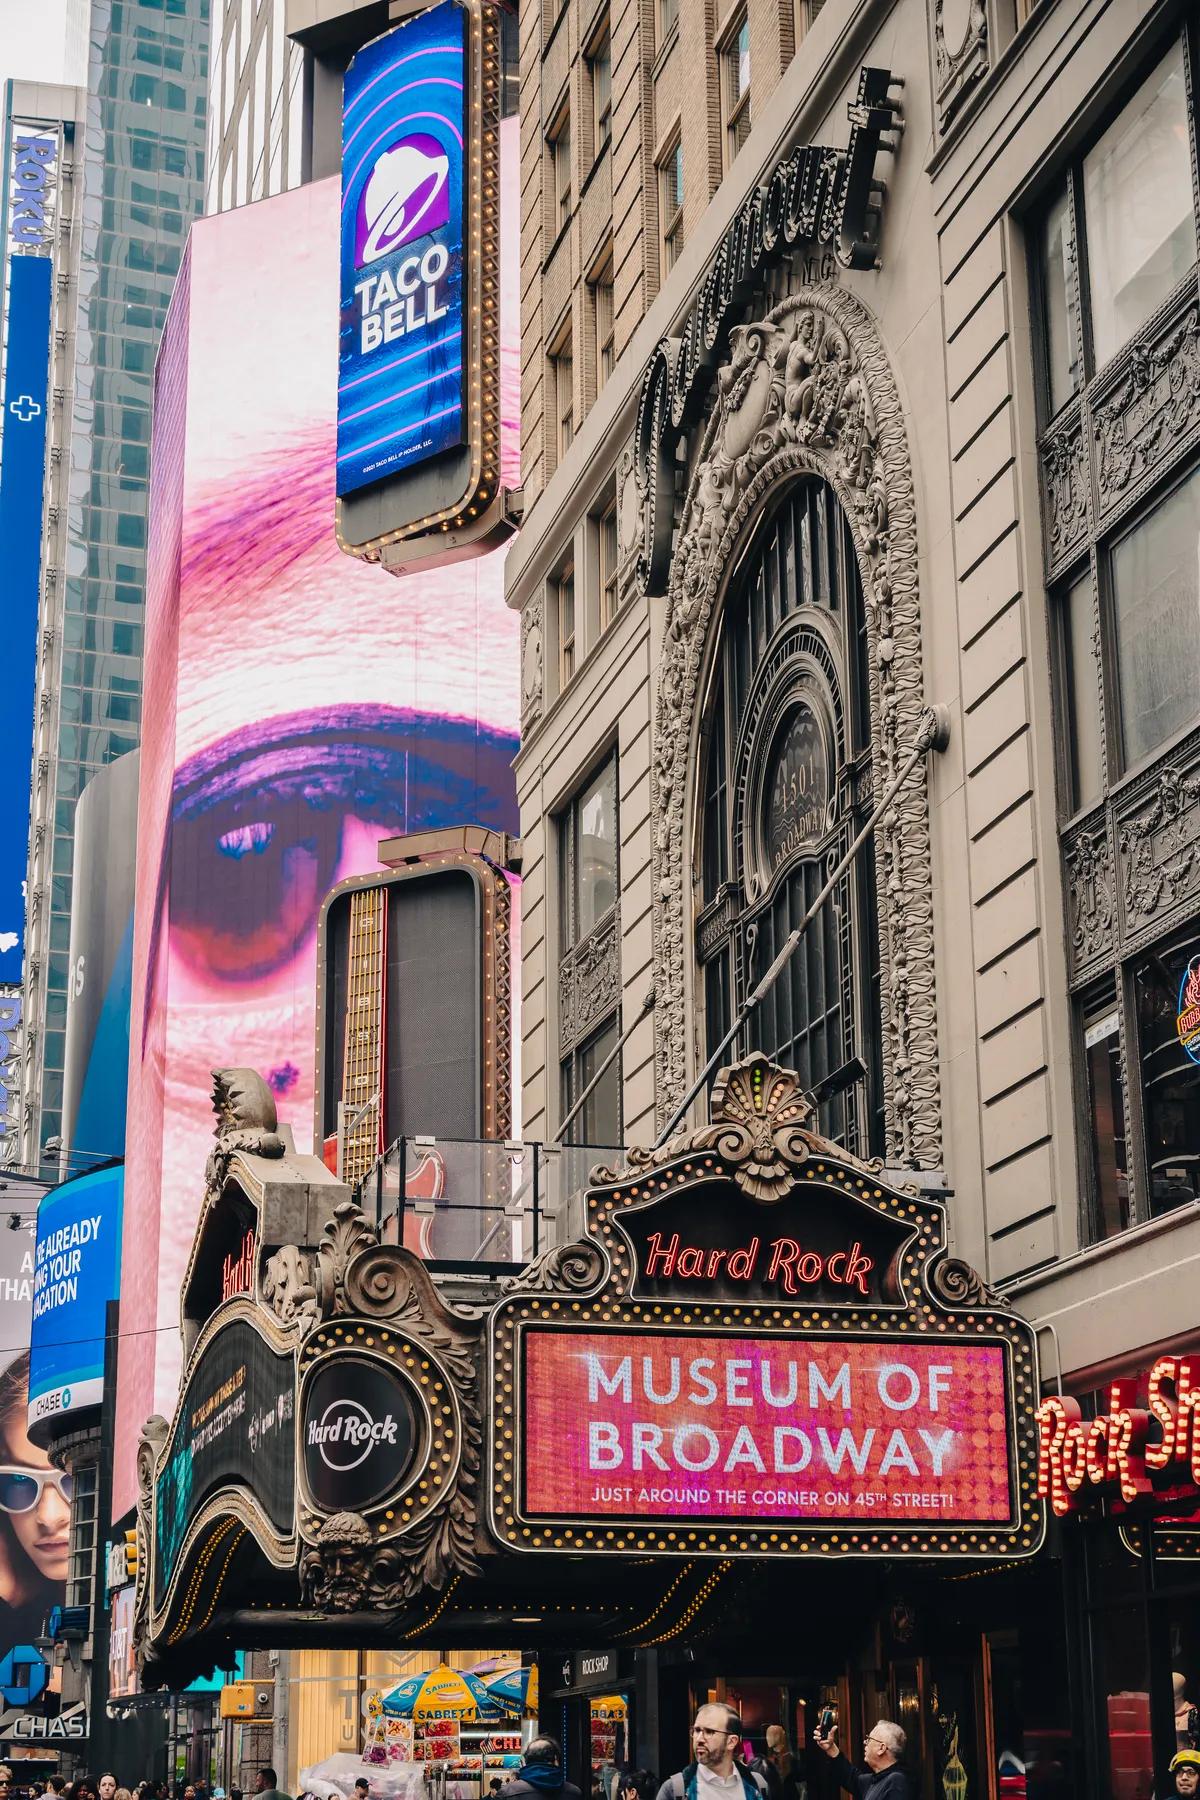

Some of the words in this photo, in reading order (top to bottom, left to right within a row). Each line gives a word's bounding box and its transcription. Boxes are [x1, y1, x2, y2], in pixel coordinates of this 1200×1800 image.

[354, 244, 449, 316] TACO
[361, 285, 449, 355] BELL
[376, 459, 387, 468] TACO
[388, 454, 397, 462] BELL
[783, 754, 814, 813] 1501
[45, 1215, 102, 1260] ALREADY
[49, 1249, 81, 1283] YOUR
[645, 1232, 759, 1278] Hard
[769, 1238, 873, 1295] Rock
[0, 1279, 34, 1301] HA
[588, 1352, 852, 1409] MUSEUM
[877, 1363, 954, 1412] OF
[36, 1393, 61, 1415] CHASE
[308, 1416, 343, 1446] Hard
[343, 1414, 398, 1446] Rock
[588, 1421, 954, 1477] BROADWAY
[1034, 1377, 1140, 1517] Rock
[591, 1487, 633, 1502] JUST
[638, 1487, 711, 1504] AROUND
[716, 1489, 747, 1505] THE
[752, 1490, 819, 1506] CORNER
[824, 1491, 849, 1506] ON
[892, 1493, 954, 1509] STREET!
[582, 1659, 596, 1675] ROCK
[596, 1655, 609, 1673] SHOP
[417, 1706, 475, 1720] SABRETT
